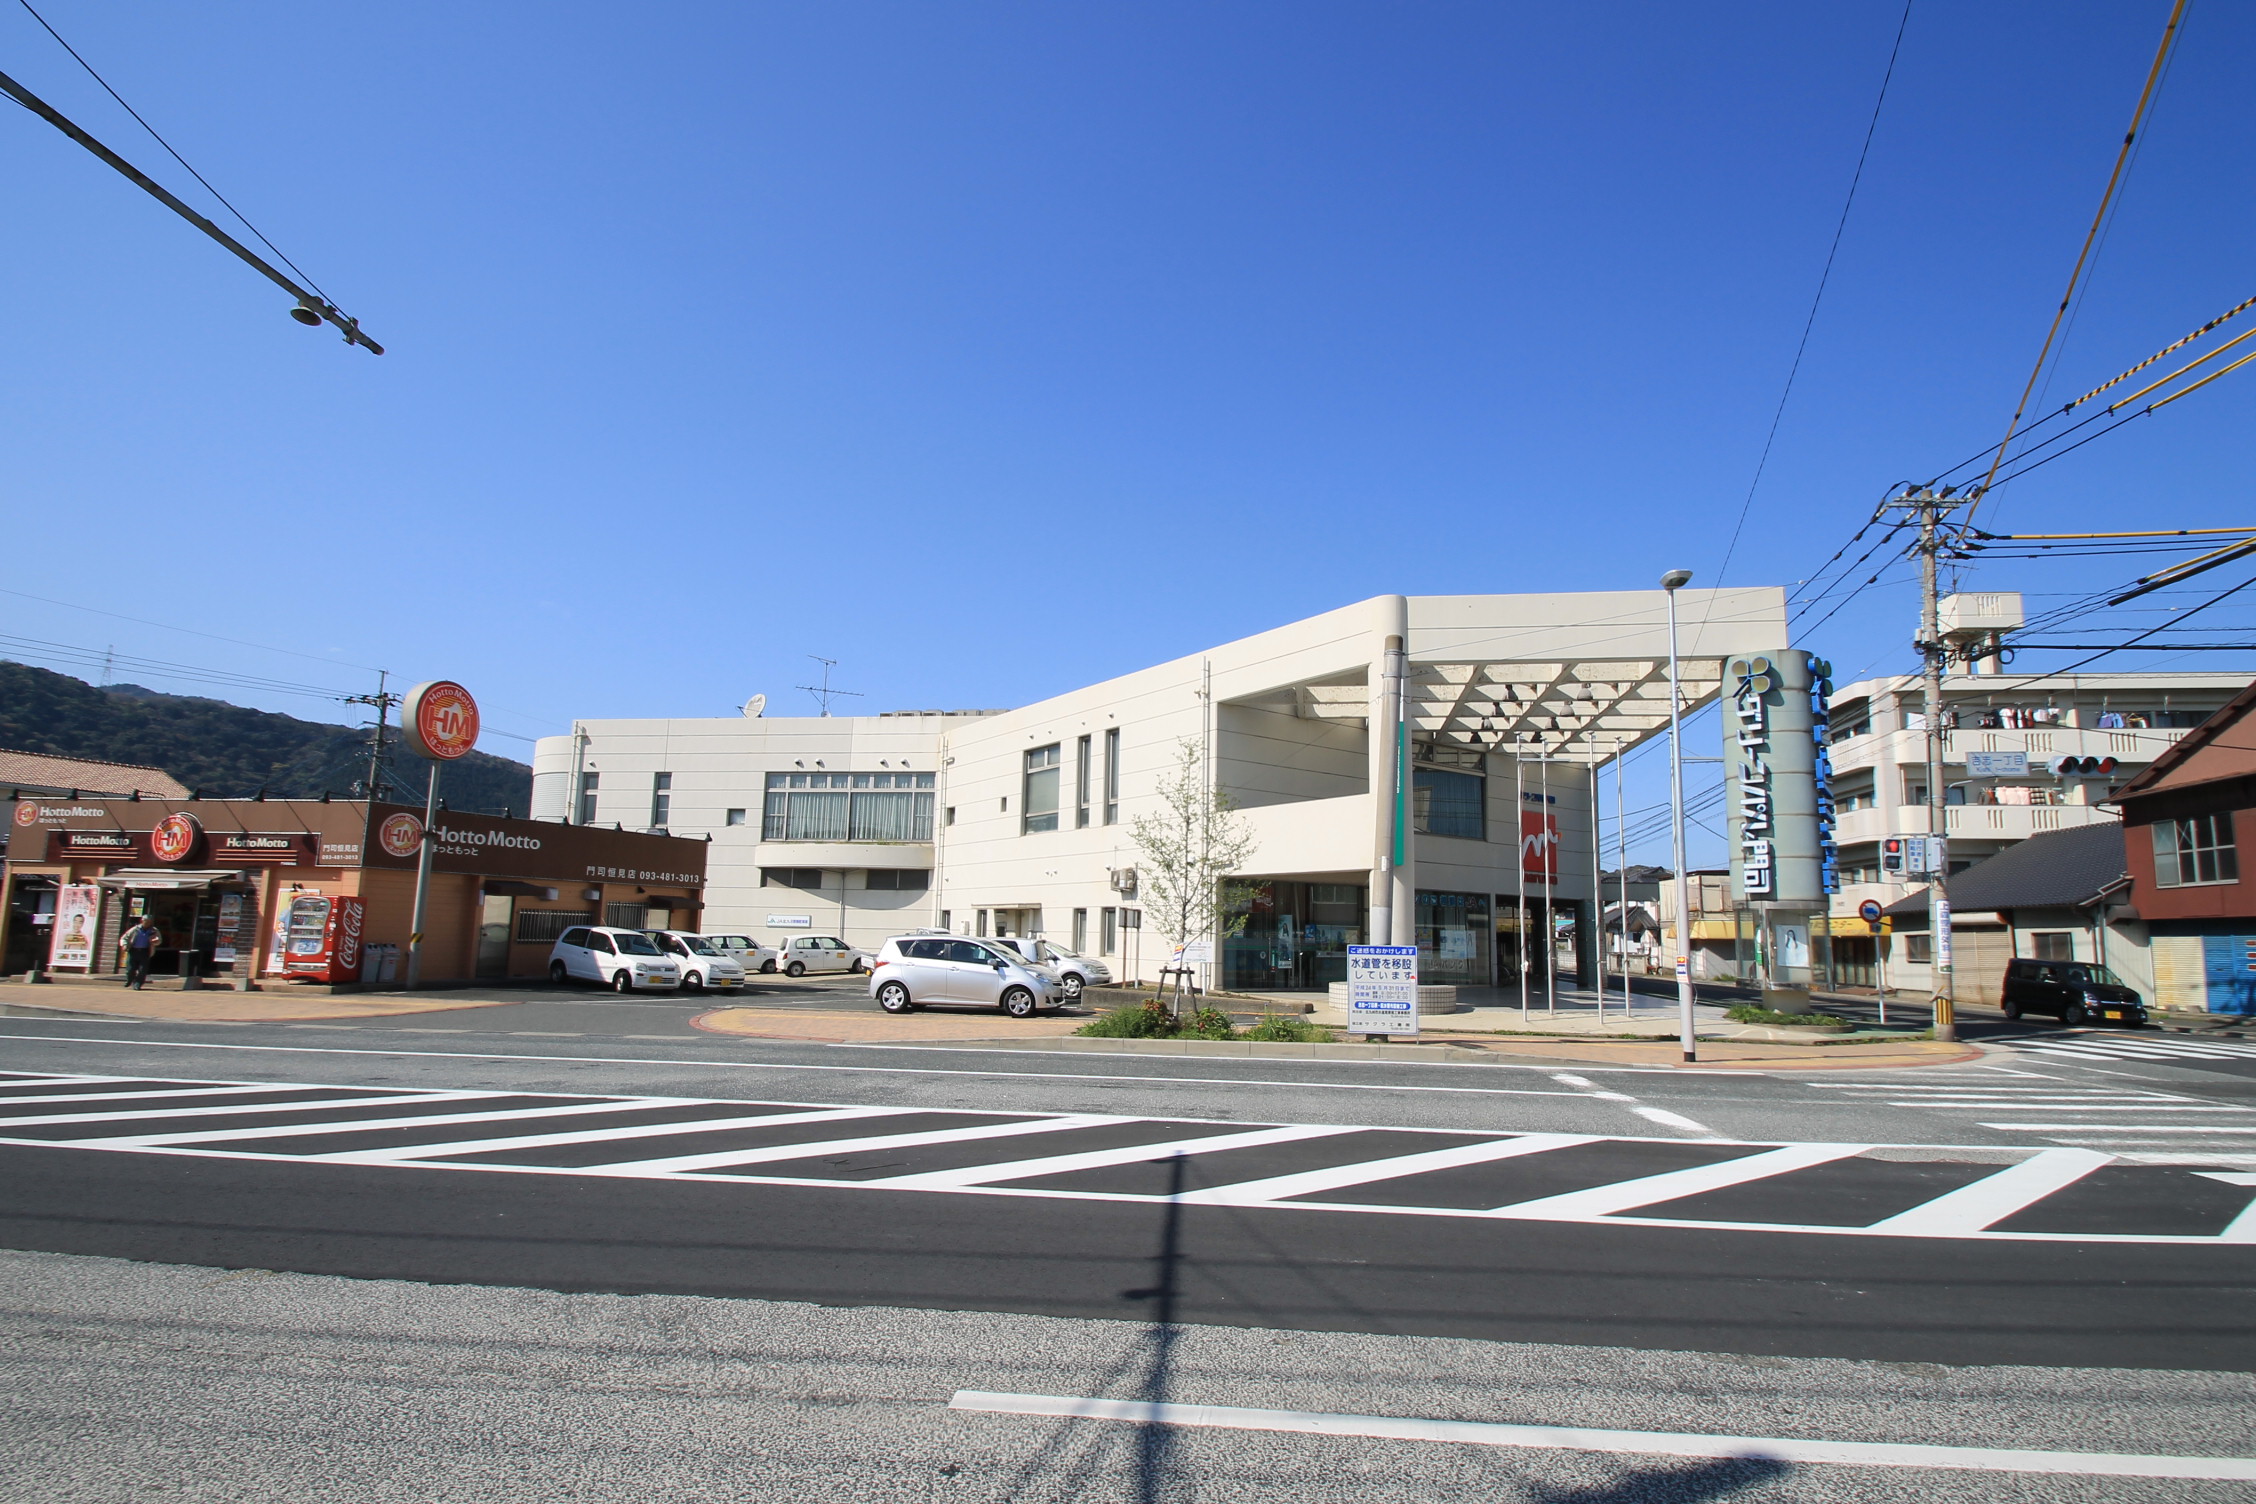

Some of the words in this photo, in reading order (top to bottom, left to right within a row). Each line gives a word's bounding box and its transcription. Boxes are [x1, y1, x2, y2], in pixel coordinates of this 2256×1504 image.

[640, 872, 699, 883] 093-481-3013
[1350, 947, 1414, 955] ご迷惑をおかけします
[1351, 958, 1412, 970] 水道管を移設
[1355, 970, 1412, 980] しています
